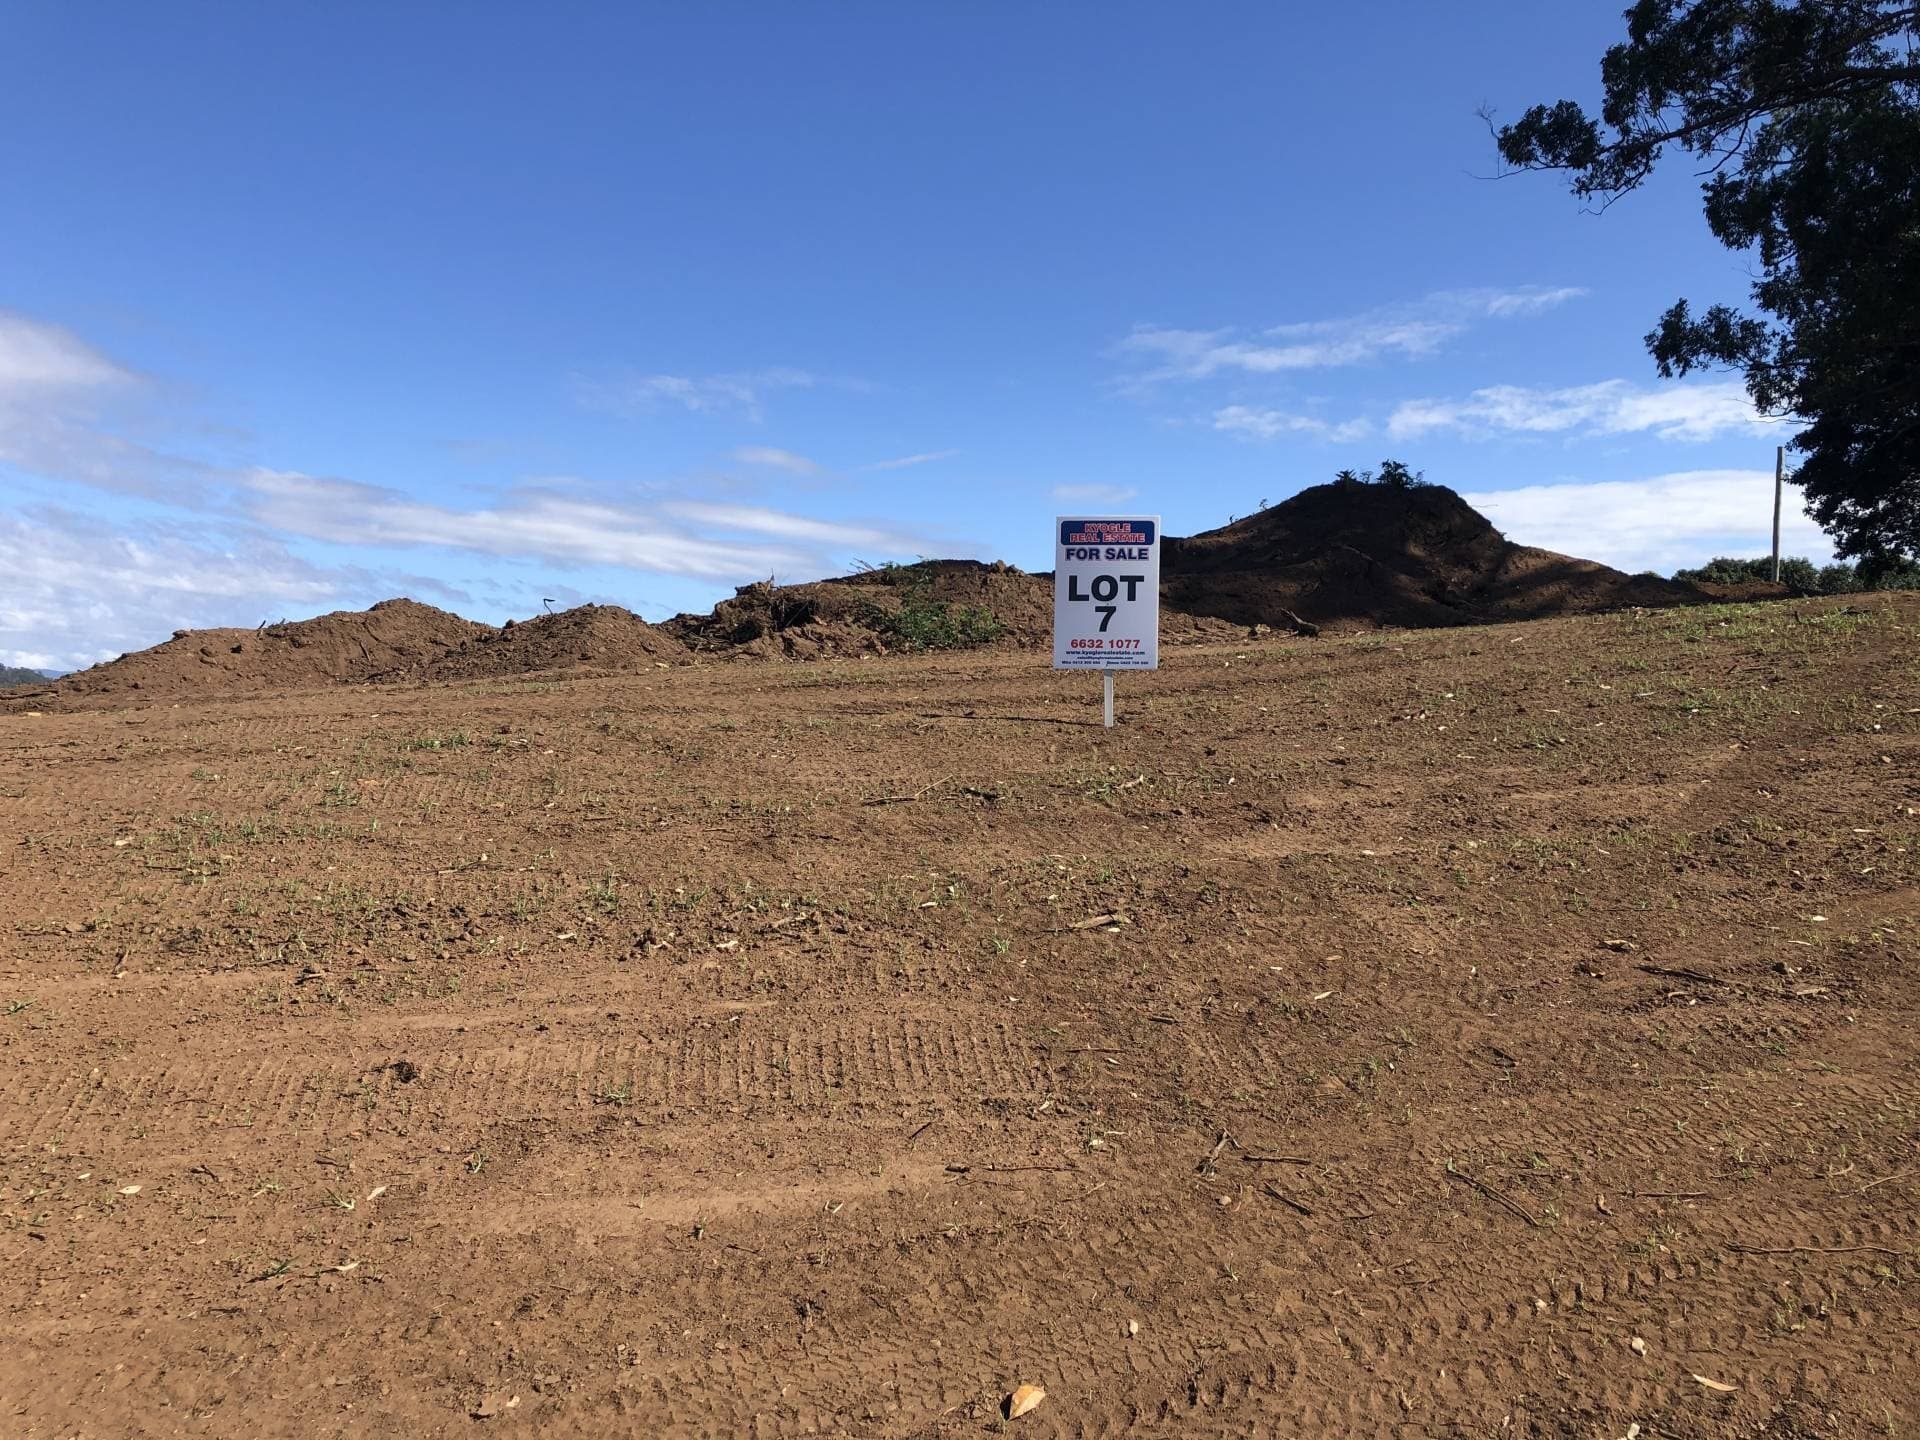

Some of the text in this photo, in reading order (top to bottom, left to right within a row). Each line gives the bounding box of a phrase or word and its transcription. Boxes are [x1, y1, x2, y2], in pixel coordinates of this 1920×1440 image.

[1084, 523, 1131, 533] KYOGLE
[1069, 533, 1146, 543] REAL ESTATE
[1066, 548, 1149, 560] FOR SALE
[1068, 574, 1145, 602] LOT
[1094, 606, 1117, 632] 7
[1070, 639, 1141, 649] 6632 1077
